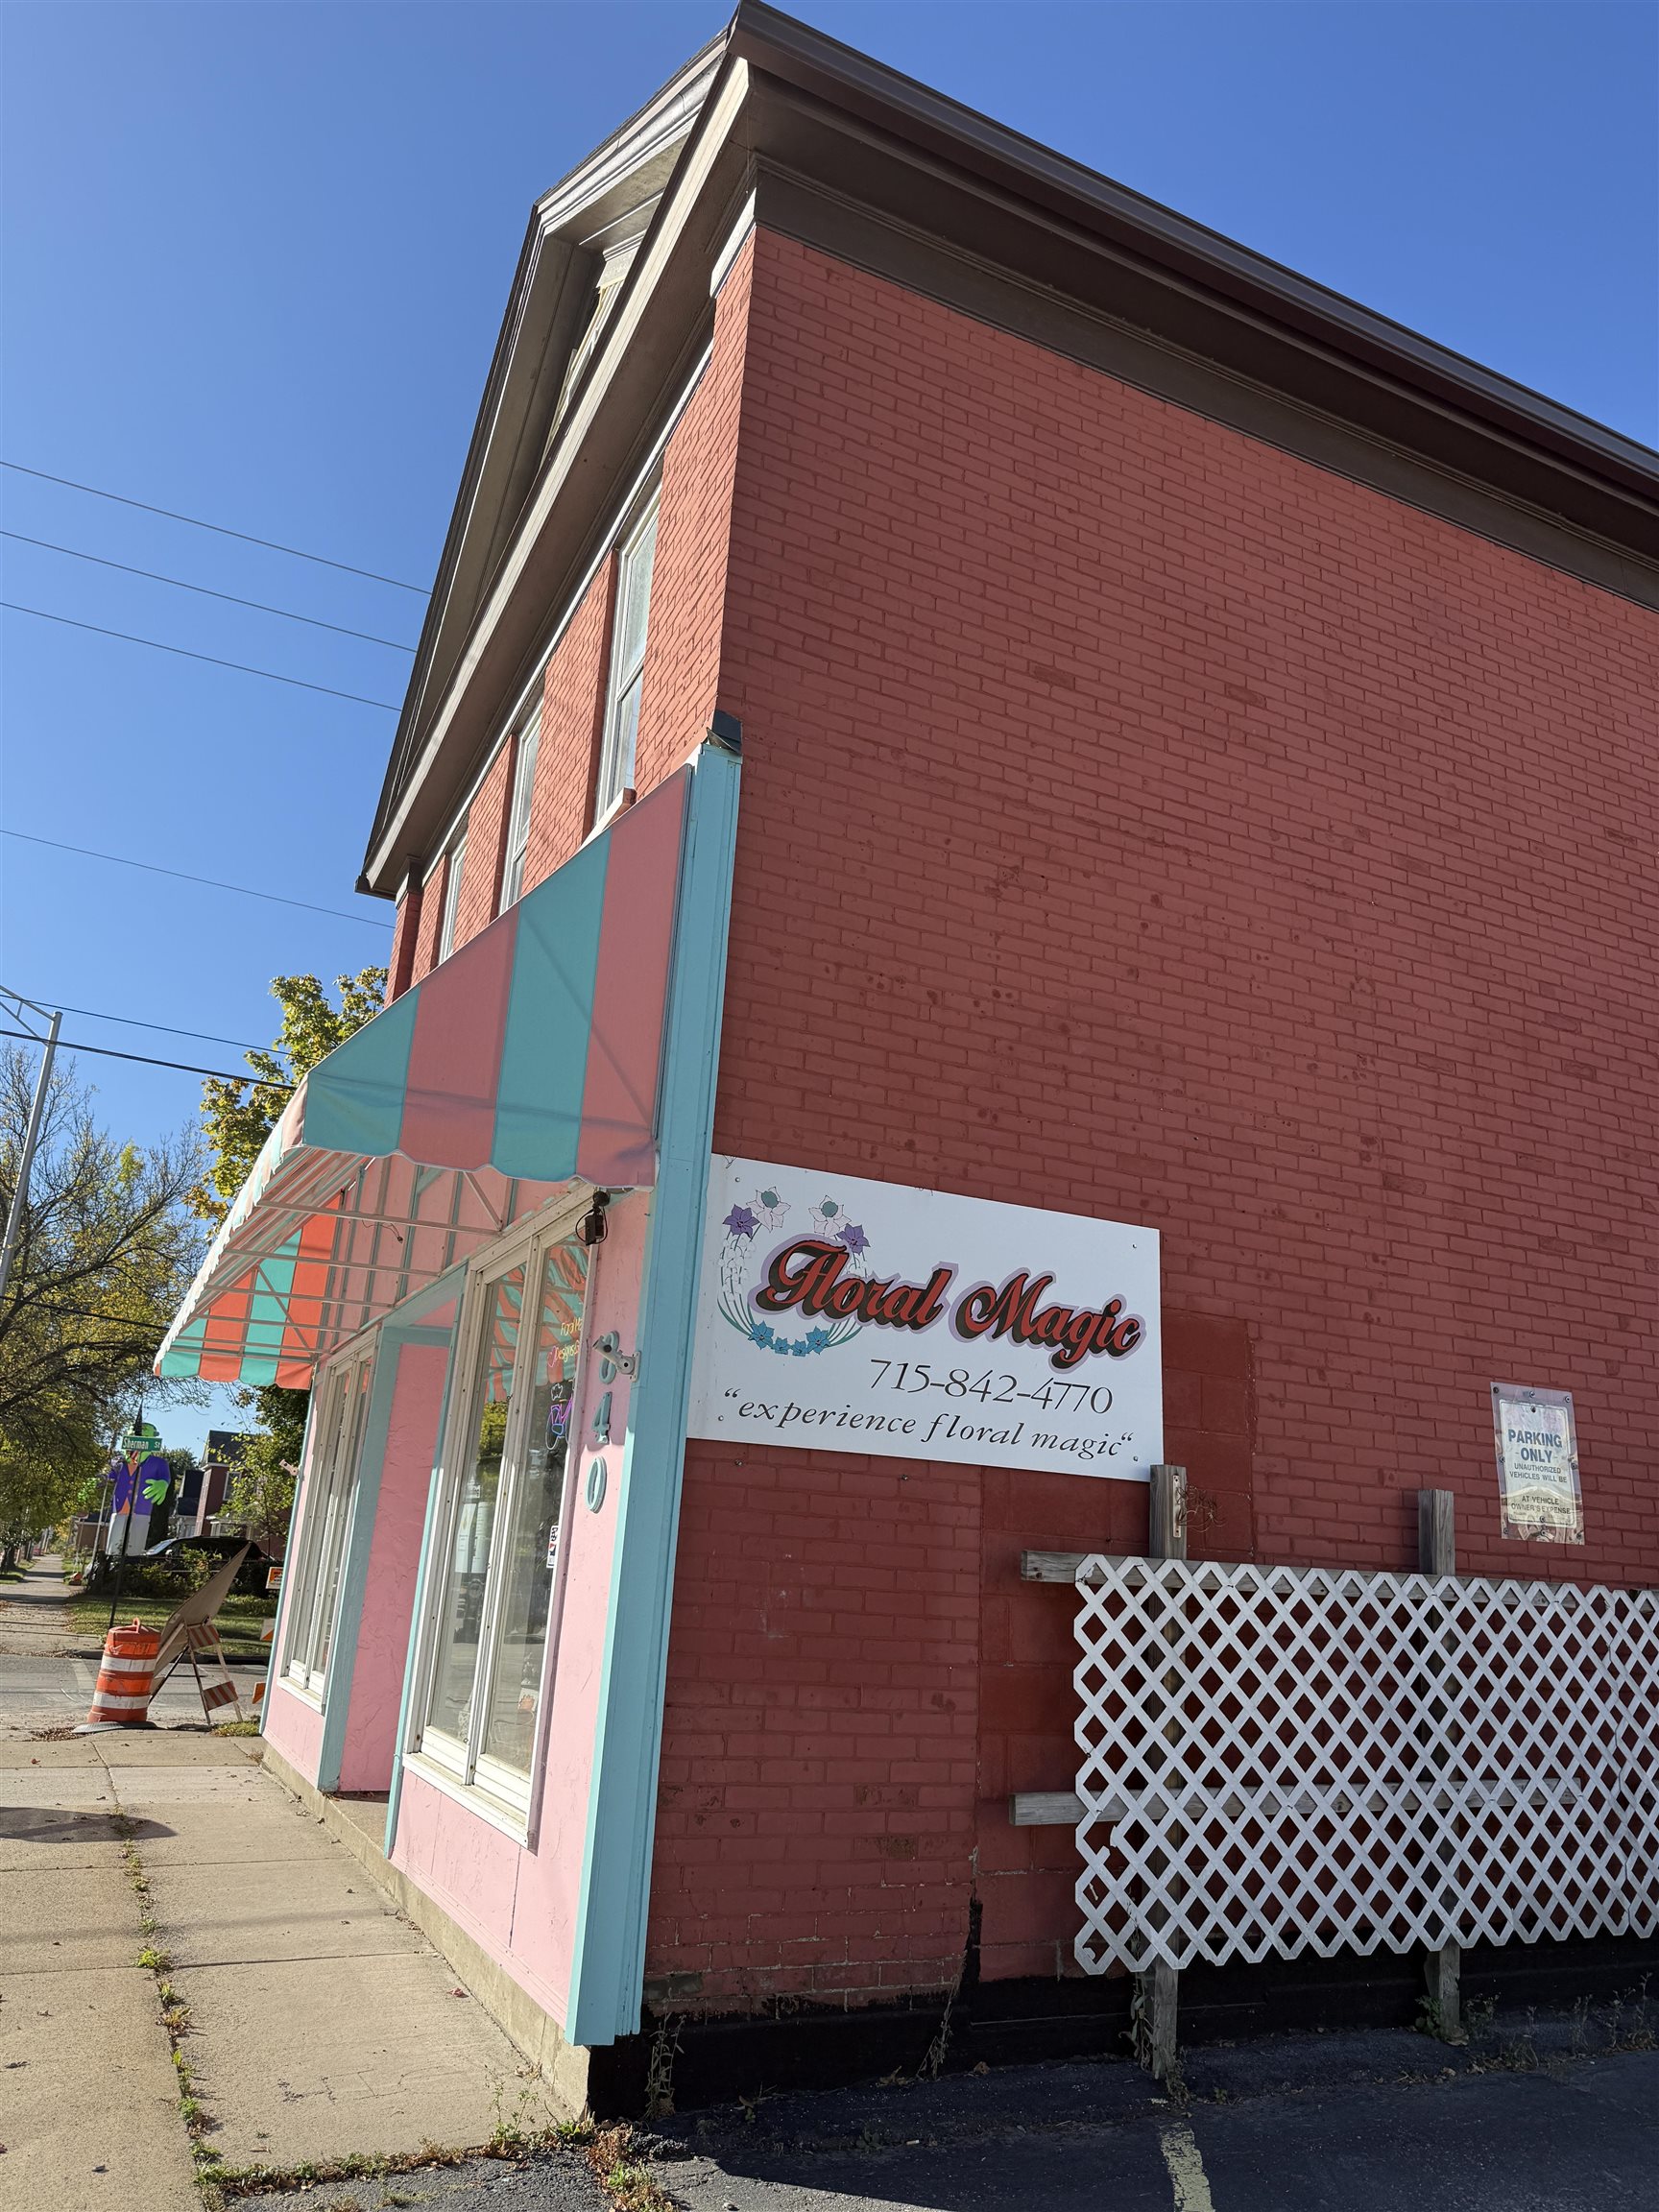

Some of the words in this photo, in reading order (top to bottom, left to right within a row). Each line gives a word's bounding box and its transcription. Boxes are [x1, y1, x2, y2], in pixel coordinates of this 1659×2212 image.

[753, 1237, 954, 1333] Floral
[956, 1272, 1144, 1370] Magic
[869, 1358, 1114, 1414] 715-842-4770
[921, 1413, 1024, 1443] floral
[123, 1437, 149, 1449] Sherman
[1508, 1429, 1562, 1448] PARKING
[1520, 1447, 1552, 1463] ONLY
[1514, 1462, 1561, 1474] UNAUTHORIZED
[1509, 1471, 1540, 1480] VEHICLES
[1531, 1496, 1560, 1505] VEHICLE
[1510, 1503, 1541, 1512] OWNER'S
[1541, 1505, 1572, 1515] EXPENSE
